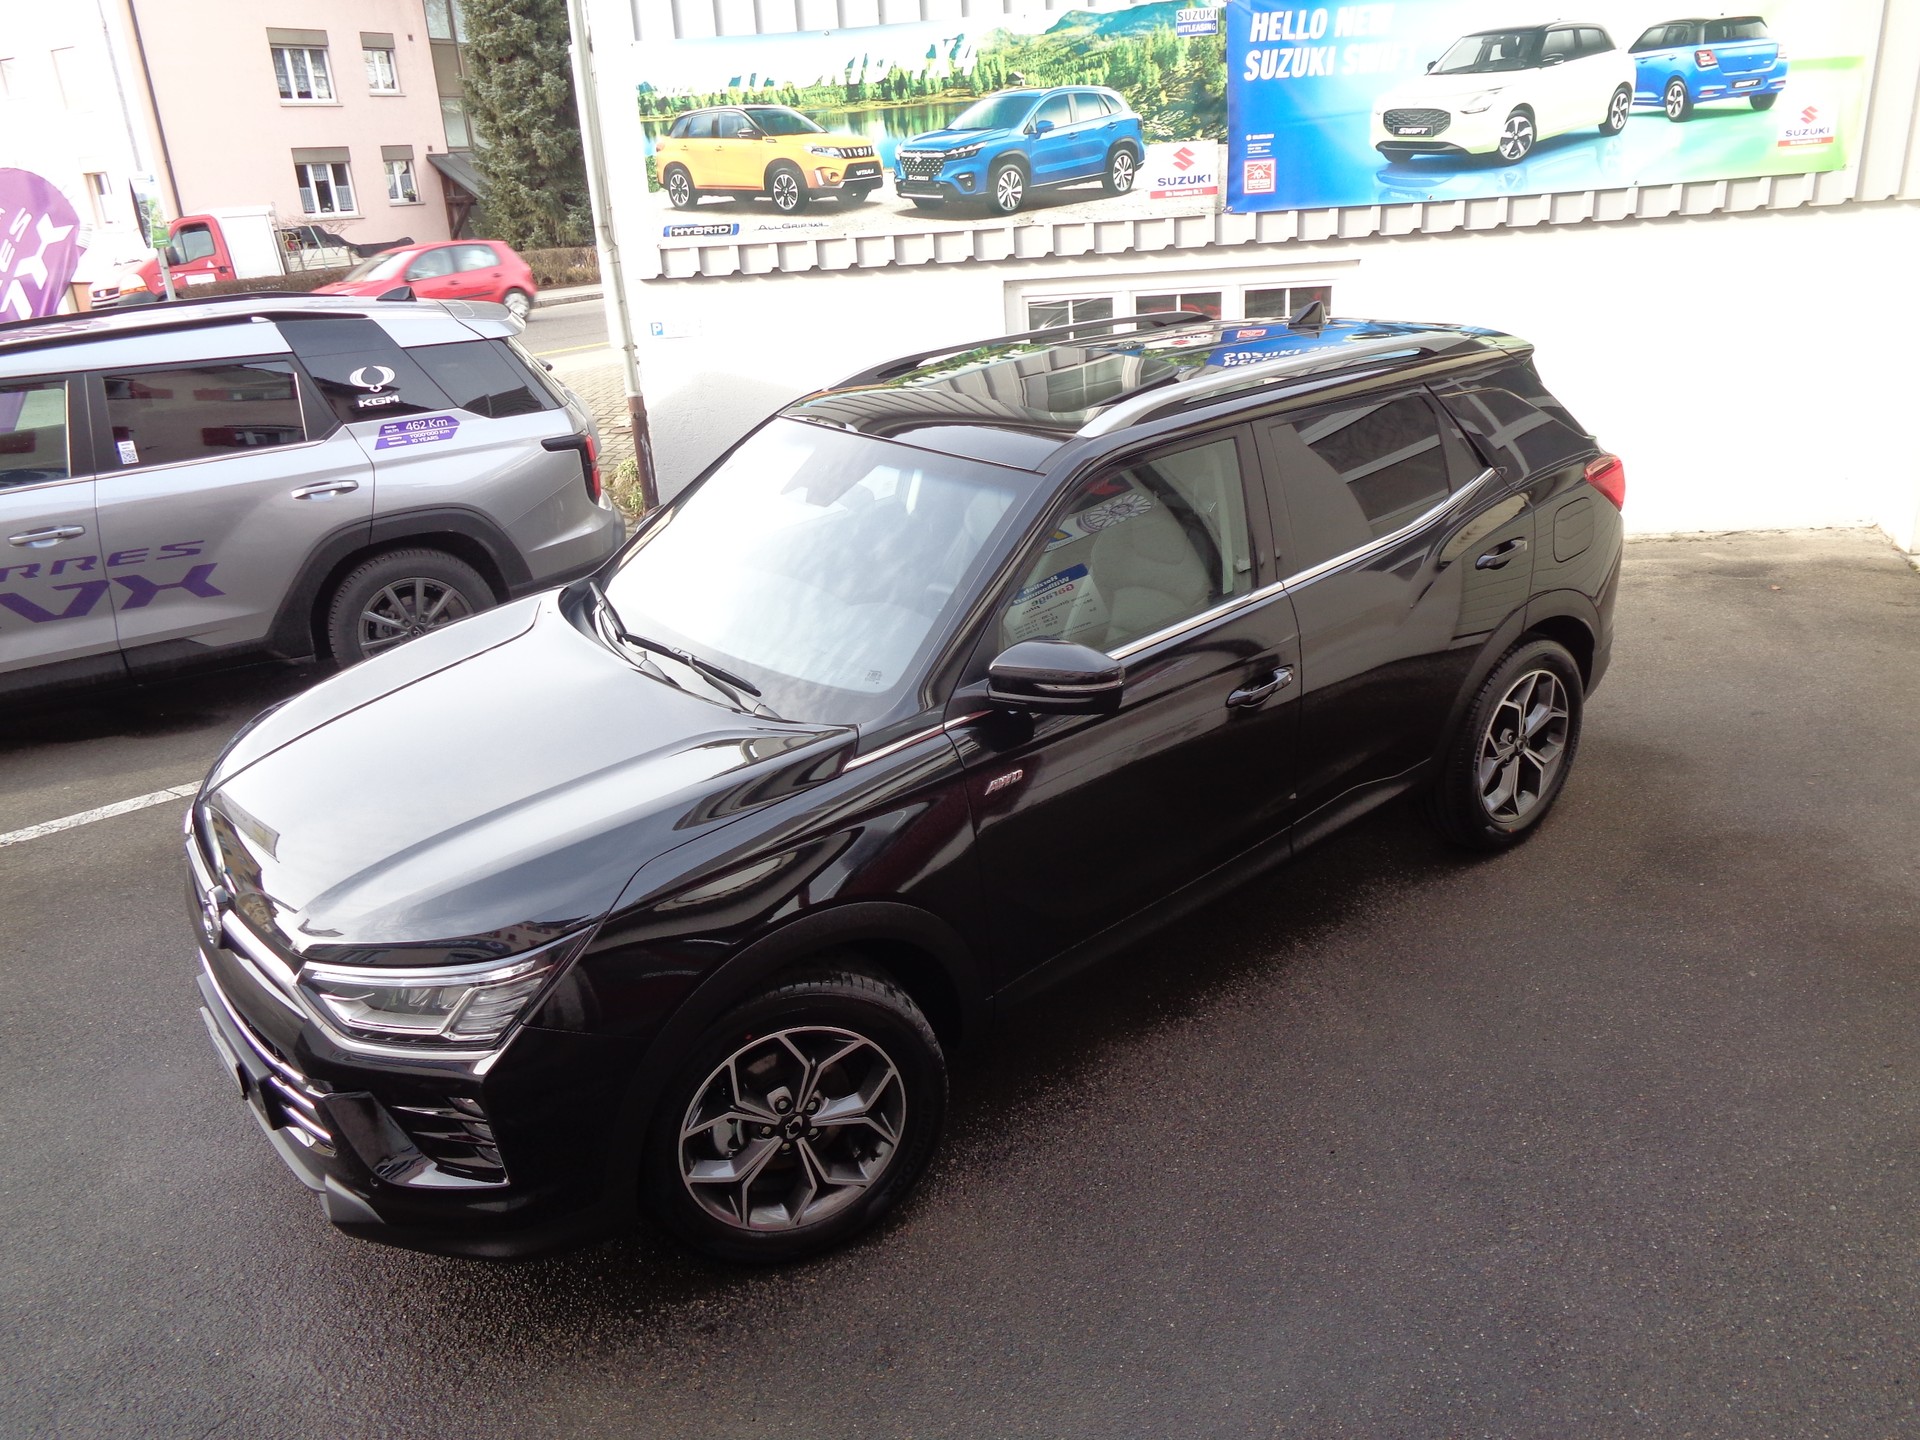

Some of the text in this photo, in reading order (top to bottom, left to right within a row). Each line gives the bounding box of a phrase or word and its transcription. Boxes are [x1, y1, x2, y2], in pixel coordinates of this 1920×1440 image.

[1177, 10, 1217, 21] SUZUKI
[1250, 8, 1329, 42] HELLO
[1244, 46, 1337, 81] SUZUKI
[1785, 127, 1830, 137] SUZUKI
[1157, 174, 1211, 187] SUZUKI
[674, 225, 730, 236] HYBRID
[358, 395, 400, 408] KGM
[405, 418, 448, 431] 462 Km
